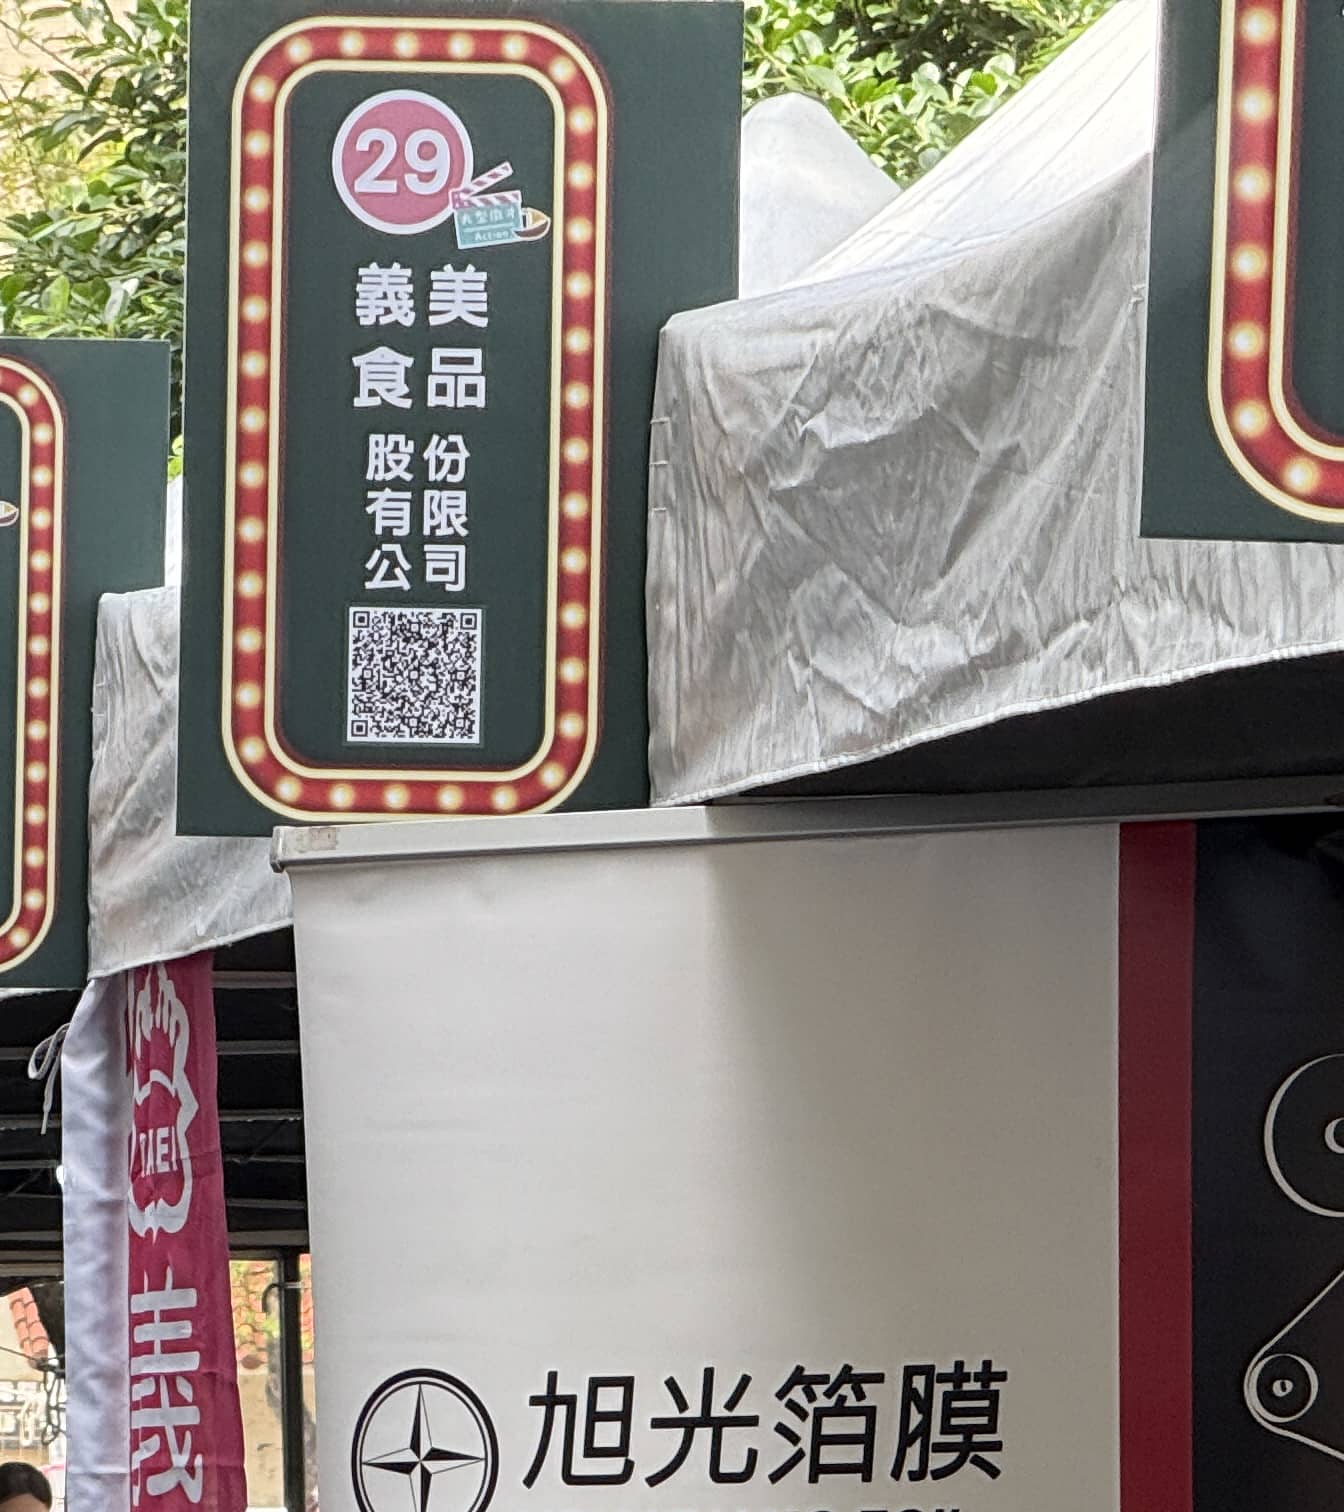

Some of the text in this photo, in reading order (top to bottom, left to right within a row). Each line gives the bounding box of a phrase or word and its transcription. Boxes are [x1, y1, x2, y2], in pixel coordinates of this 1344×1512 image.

[354, 128, 450, 196] 29
[355, 261, 489, 329] 義美
[351, 345, 486, 409] 食品
[366, 433, 471, 483] 股份
[365, 488, 470, 538] 有限
[364, 543, 467, 592] 公司
[523, 1359, 1009, 1490] 旭光箔膜
